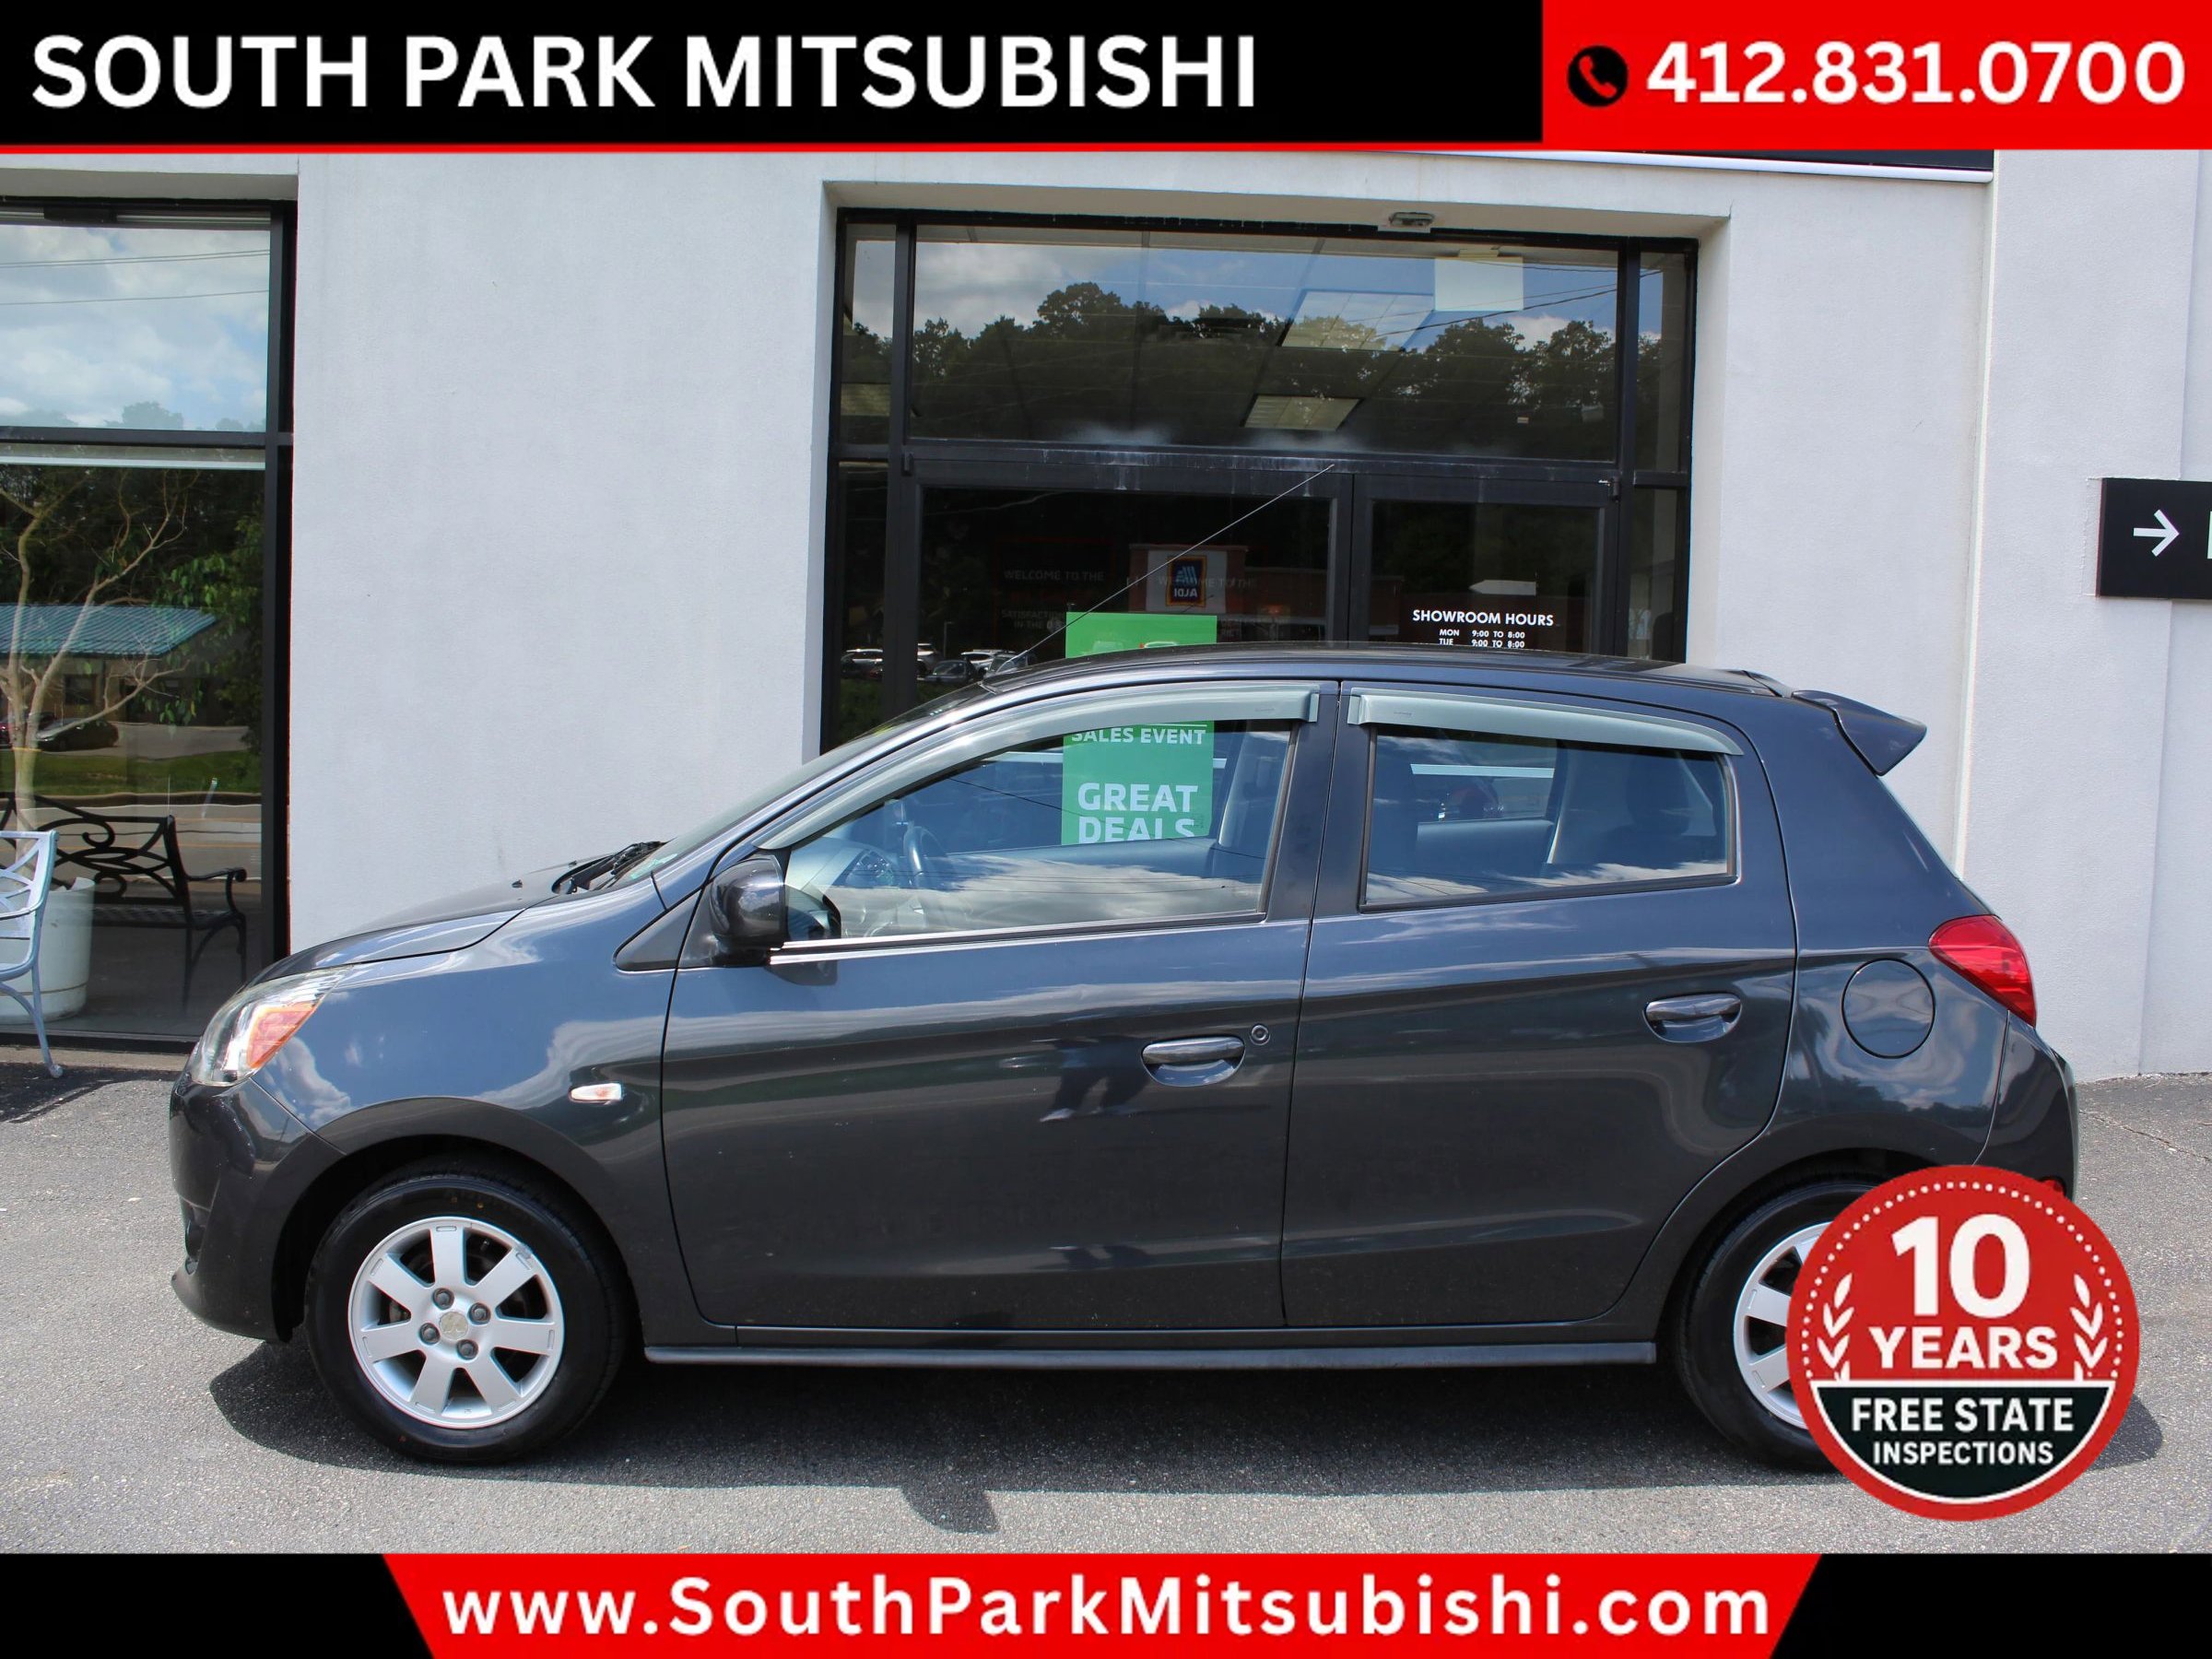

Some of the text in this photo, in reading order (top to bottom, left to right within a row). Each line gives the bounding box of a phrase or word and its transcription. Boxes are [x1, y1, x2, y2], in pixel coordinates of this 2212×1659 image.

[1004, 570, 1105, 581] WELCOME TO THE
[1413, 609, 1554, 627] SHOWROOM HOURS
[1140, 728, 1206, 745] EVENT
[1077, 782, 1198, 812] GREAT
